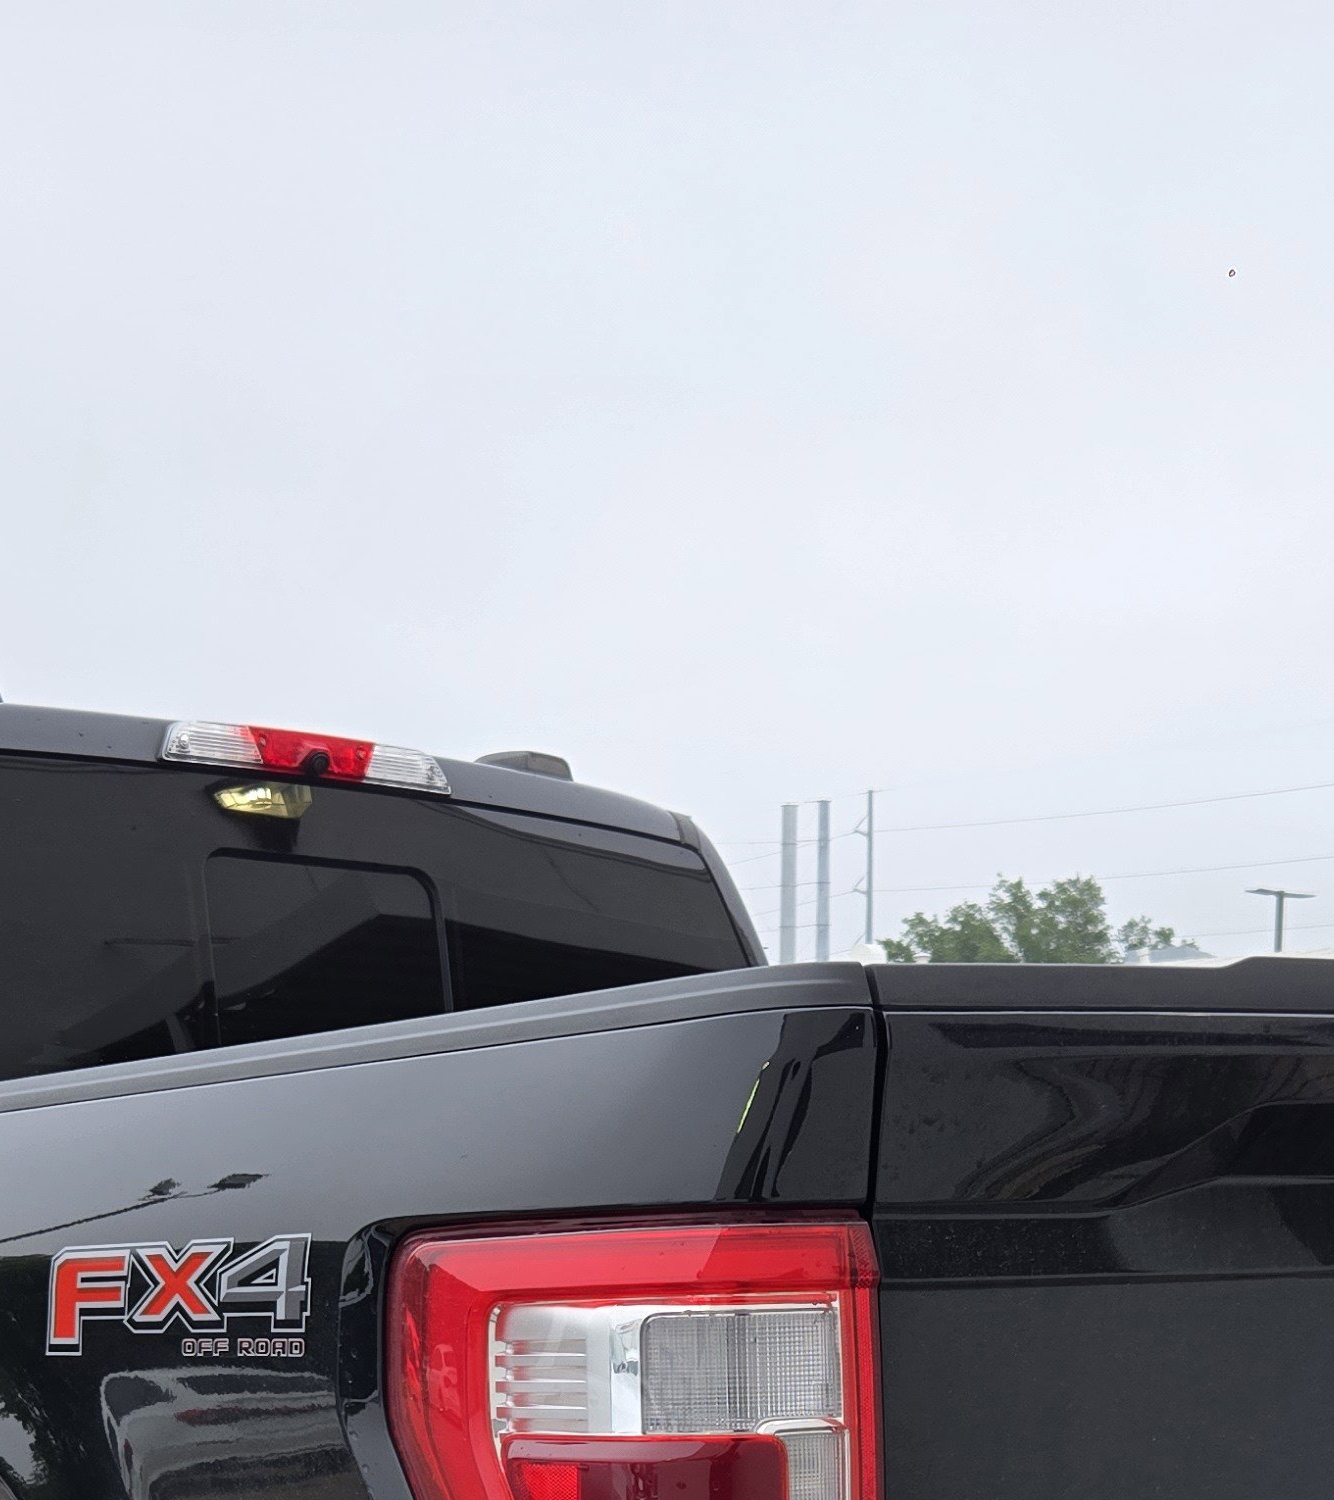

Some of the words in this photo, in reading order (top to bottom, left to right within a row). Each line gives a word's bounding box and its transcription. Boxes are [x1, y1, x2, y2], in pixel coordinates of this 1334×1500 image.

[46, 1233, 312, 1356] FX4
[181, 1338, 229, 1358] OFF
[237, 1338, 305, 1358] ROAD
